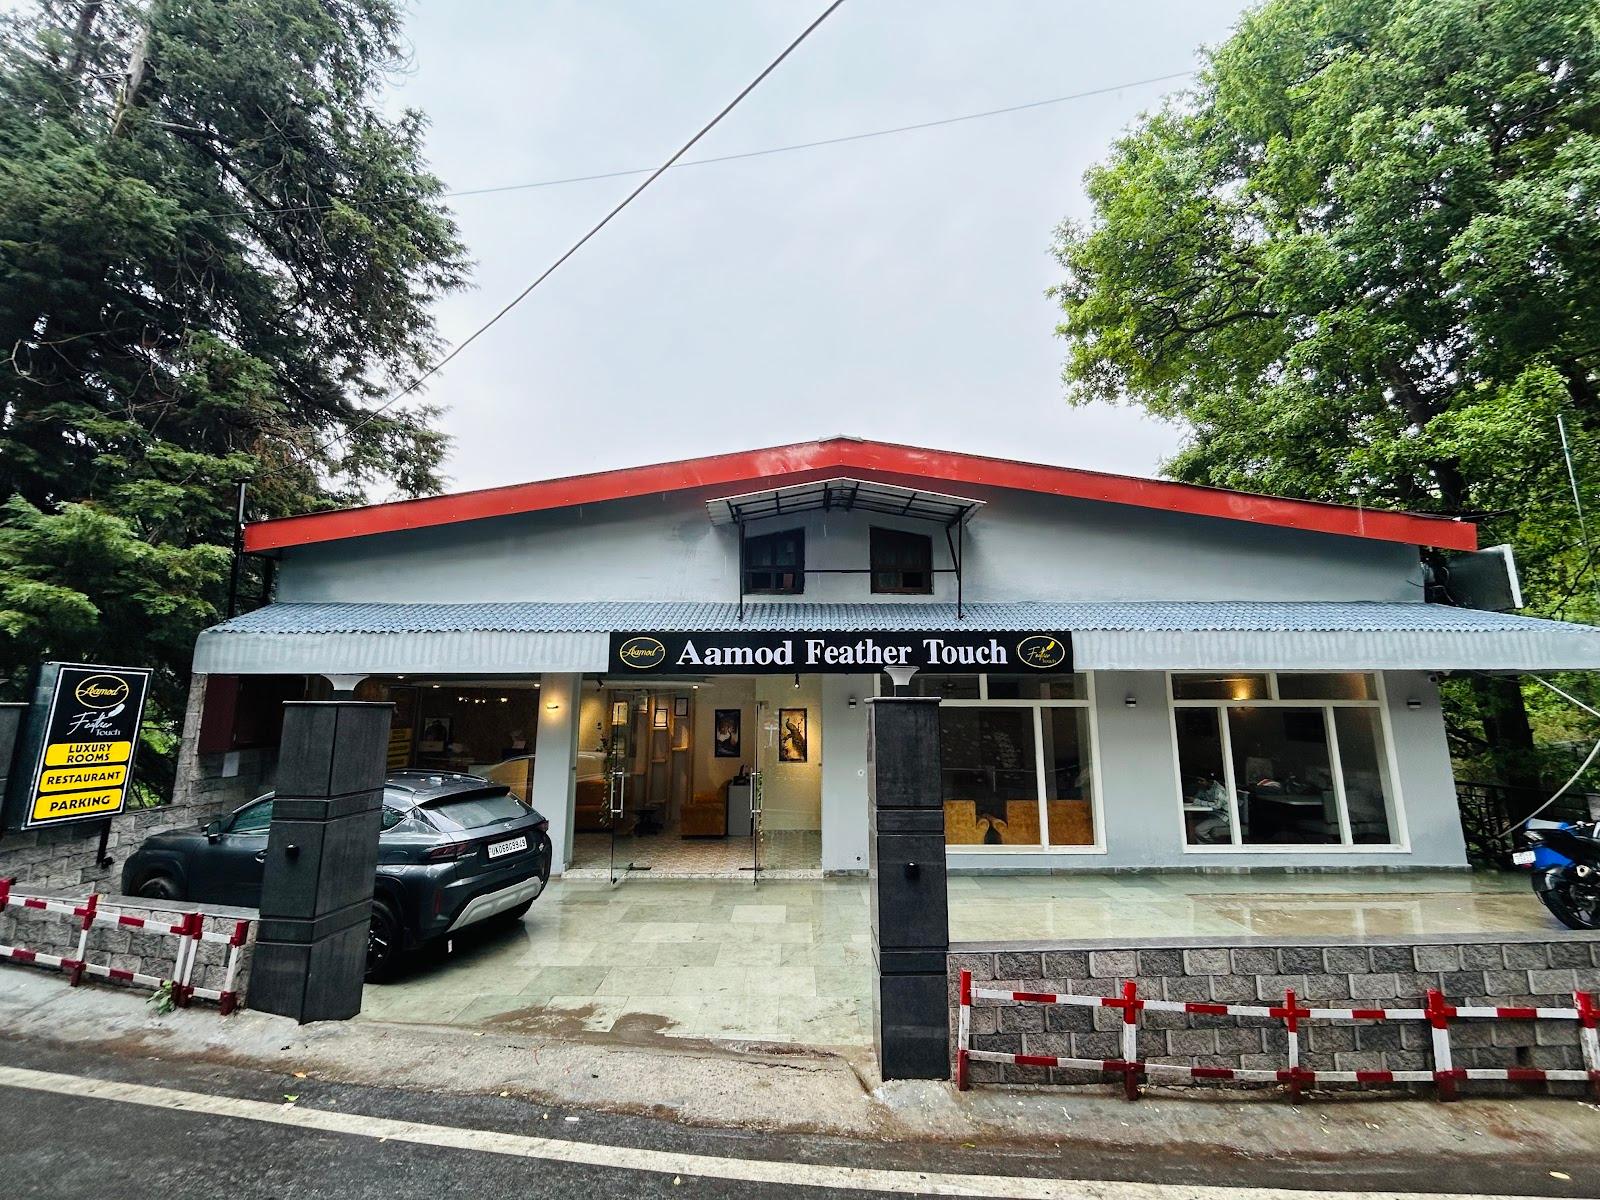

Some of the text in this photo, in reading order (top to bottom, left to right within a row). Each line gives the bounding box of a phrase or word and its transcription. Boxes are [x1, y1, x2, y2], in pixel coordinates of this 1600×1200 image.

[676, 639, 1008, 665] Aamod Feather Touch
[78, 683, 125, 697] Aamod
[68, 743, 113, 753] LUXURY
[66, 753, 110, 763] ROOMS
[46, 771, 122, 785] RESTAURANT
[49, 795, 111, 812] PARKING
